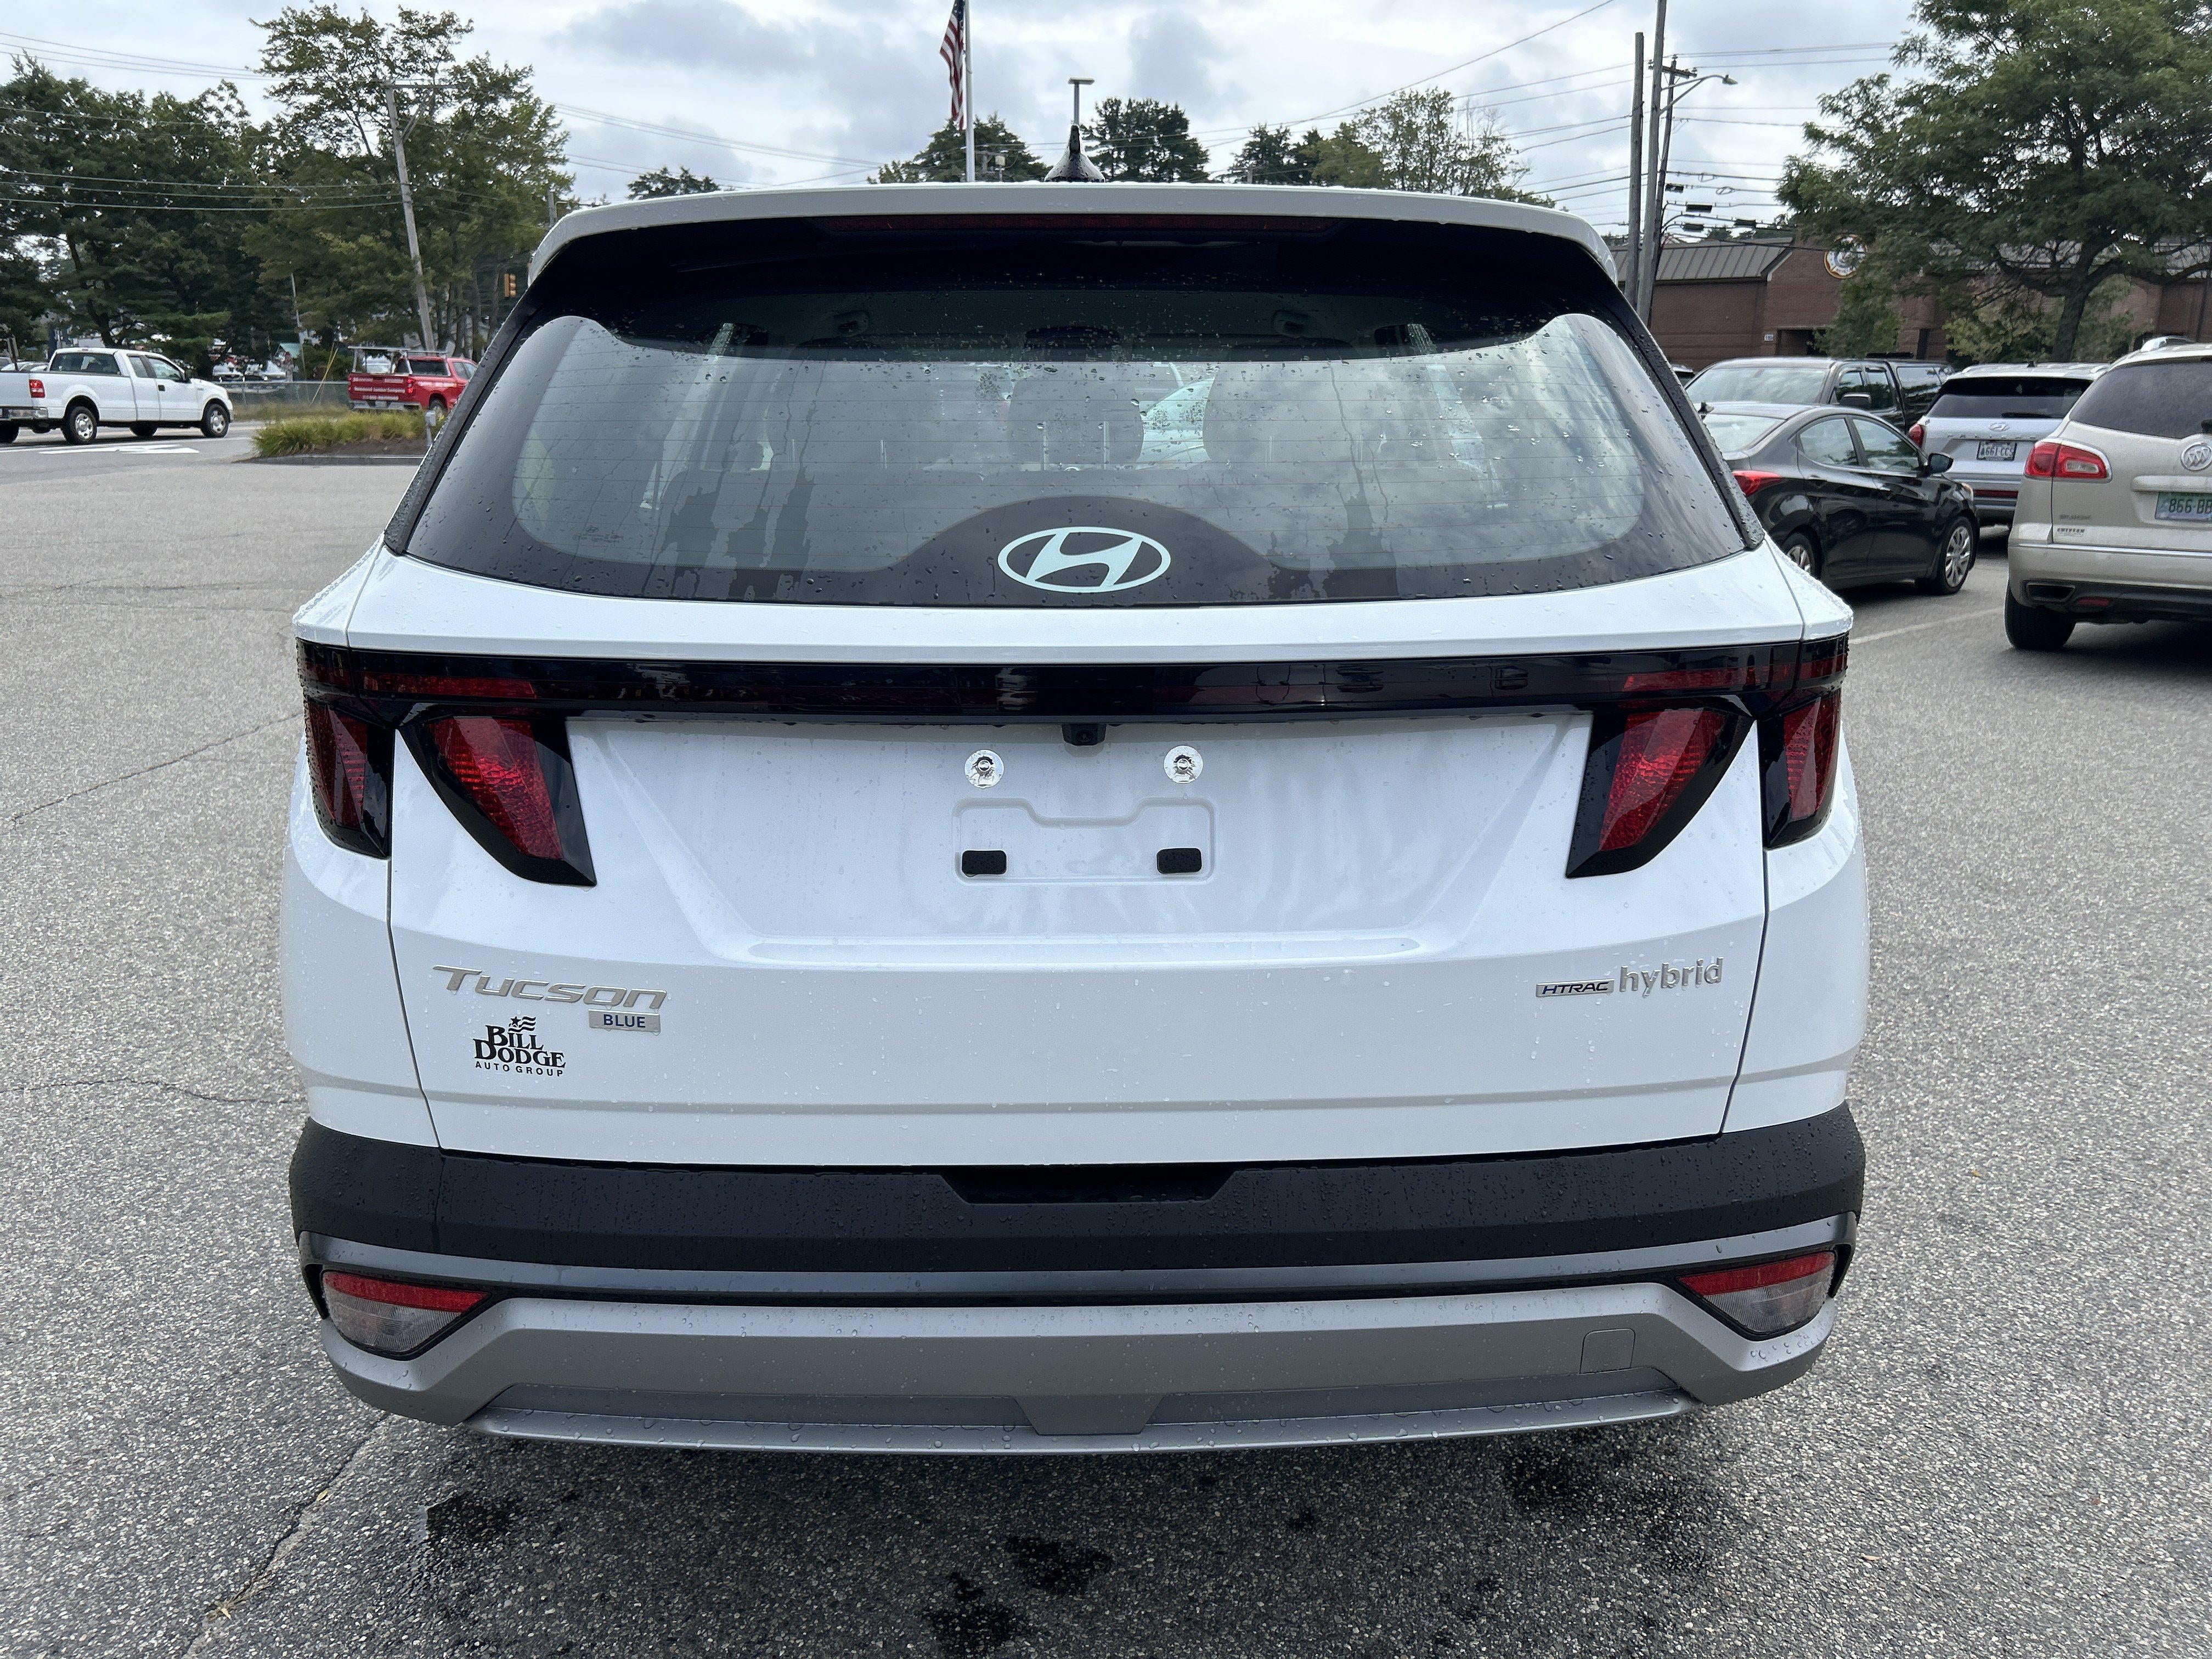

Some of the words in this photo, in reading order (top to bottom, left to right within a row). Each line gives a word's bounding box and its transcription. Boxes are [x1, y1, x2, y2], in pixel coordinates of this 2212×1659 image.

[1542, 981, 1609, 995] HTRAC
[1618, 956, 1724, 998] hybrid
[603, 1014, 646, 1028] BLUE
[475, 1061, 510, 1072] AUTO
[515, 1065, 563, 1077] GROUP
